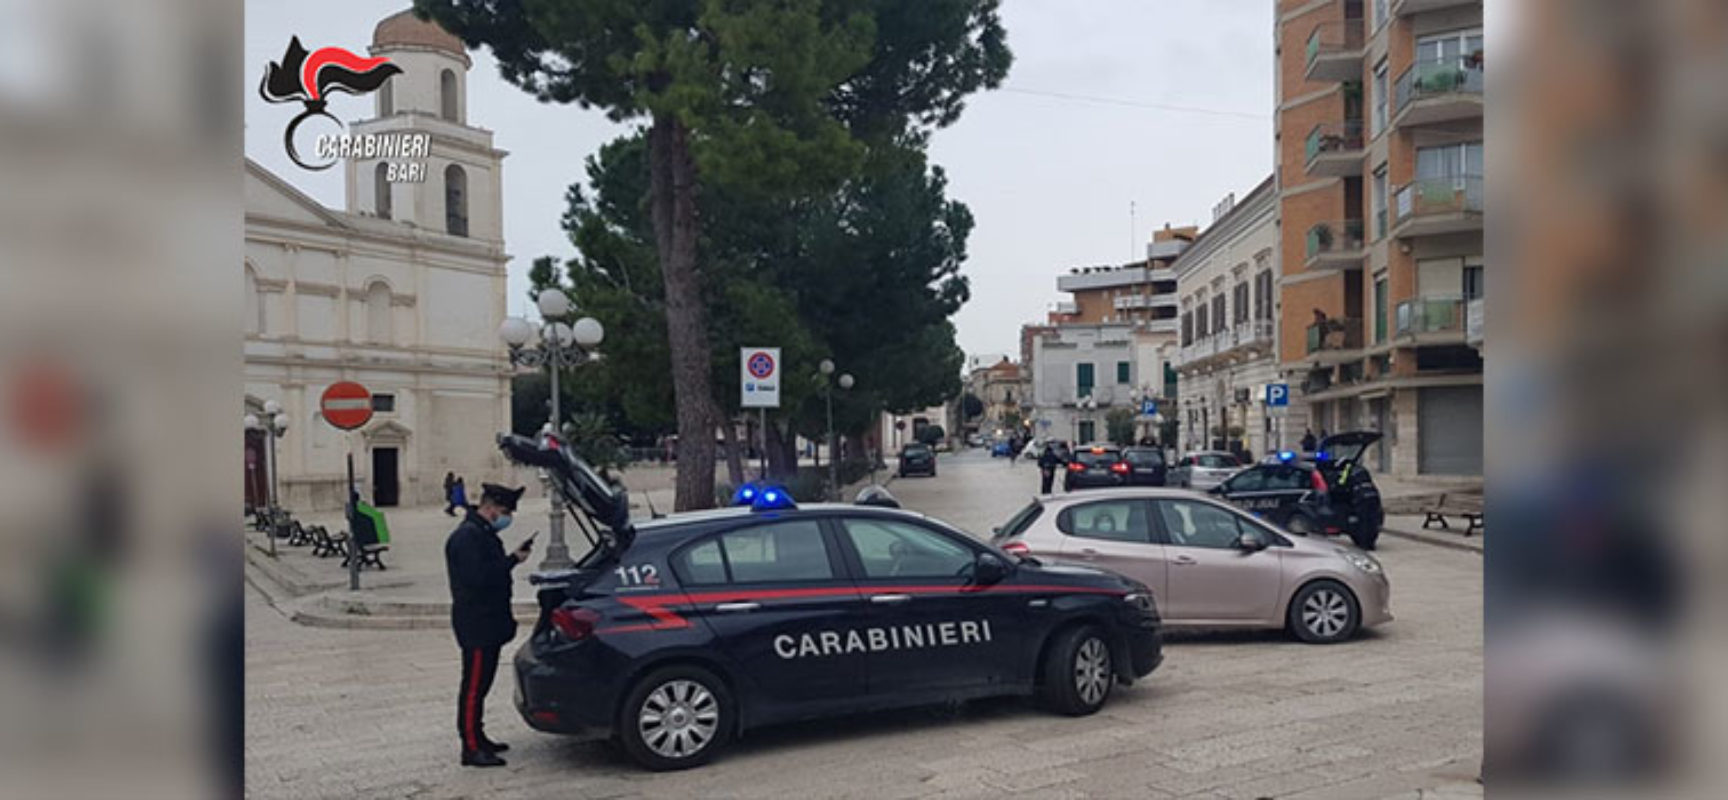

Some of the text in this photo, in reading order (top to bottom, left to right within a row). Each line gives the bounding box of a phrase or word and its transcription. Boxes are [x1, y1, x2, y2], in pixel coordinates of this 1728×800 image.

[1271, 386, 1283, 404] P
[614, 564, 660, 585] 112
[773, 619, 992, 659] CARABINIERI
